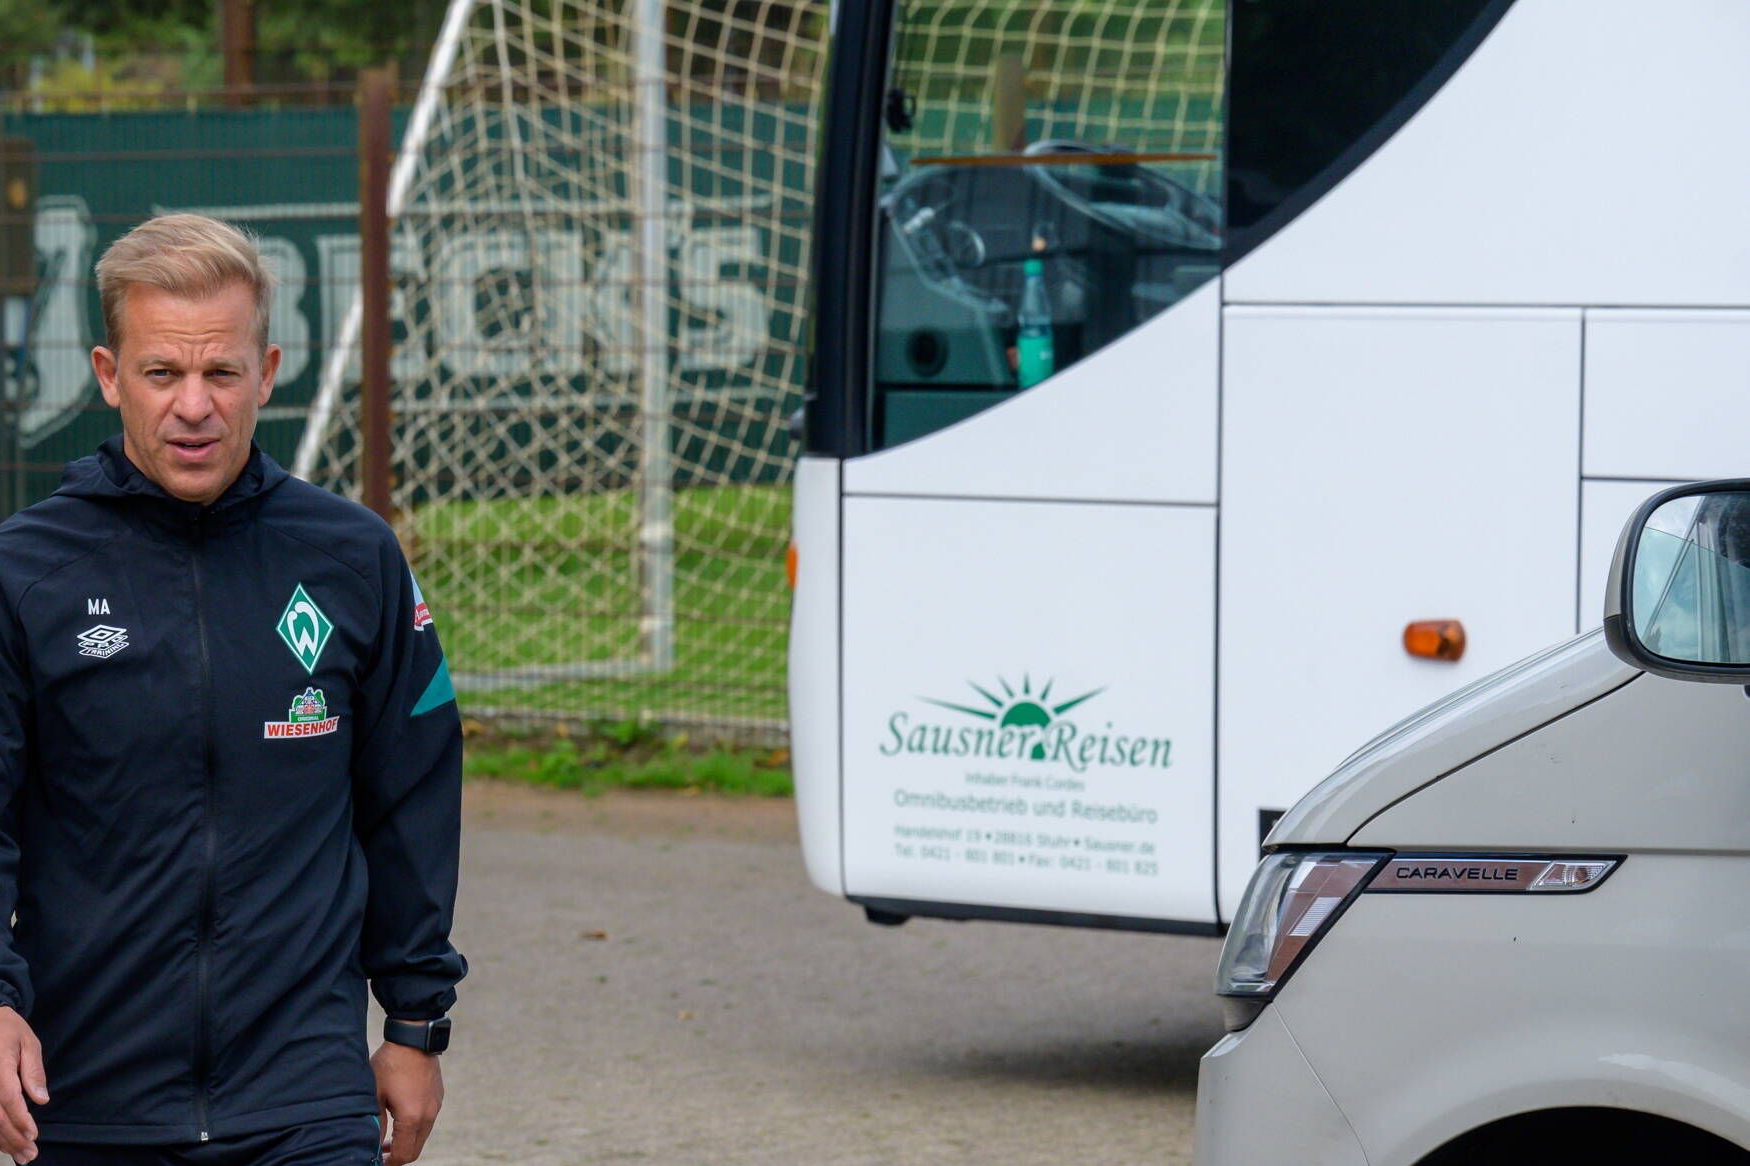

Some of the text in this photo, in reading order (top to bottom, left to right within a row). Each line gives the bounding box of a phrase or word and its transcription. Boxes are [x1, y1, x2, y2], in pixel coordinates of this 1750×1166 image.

[88, 598, 111, 615] MA
[267, 718, 338, 737] WIESENHOF
[879, 711, 1173, 773] Sausner Reisen
[894, 789, 1158, 824] Omnibusbetrieb und Reisebüro
[1396, 867, 1519, 880] CARAVELLE
